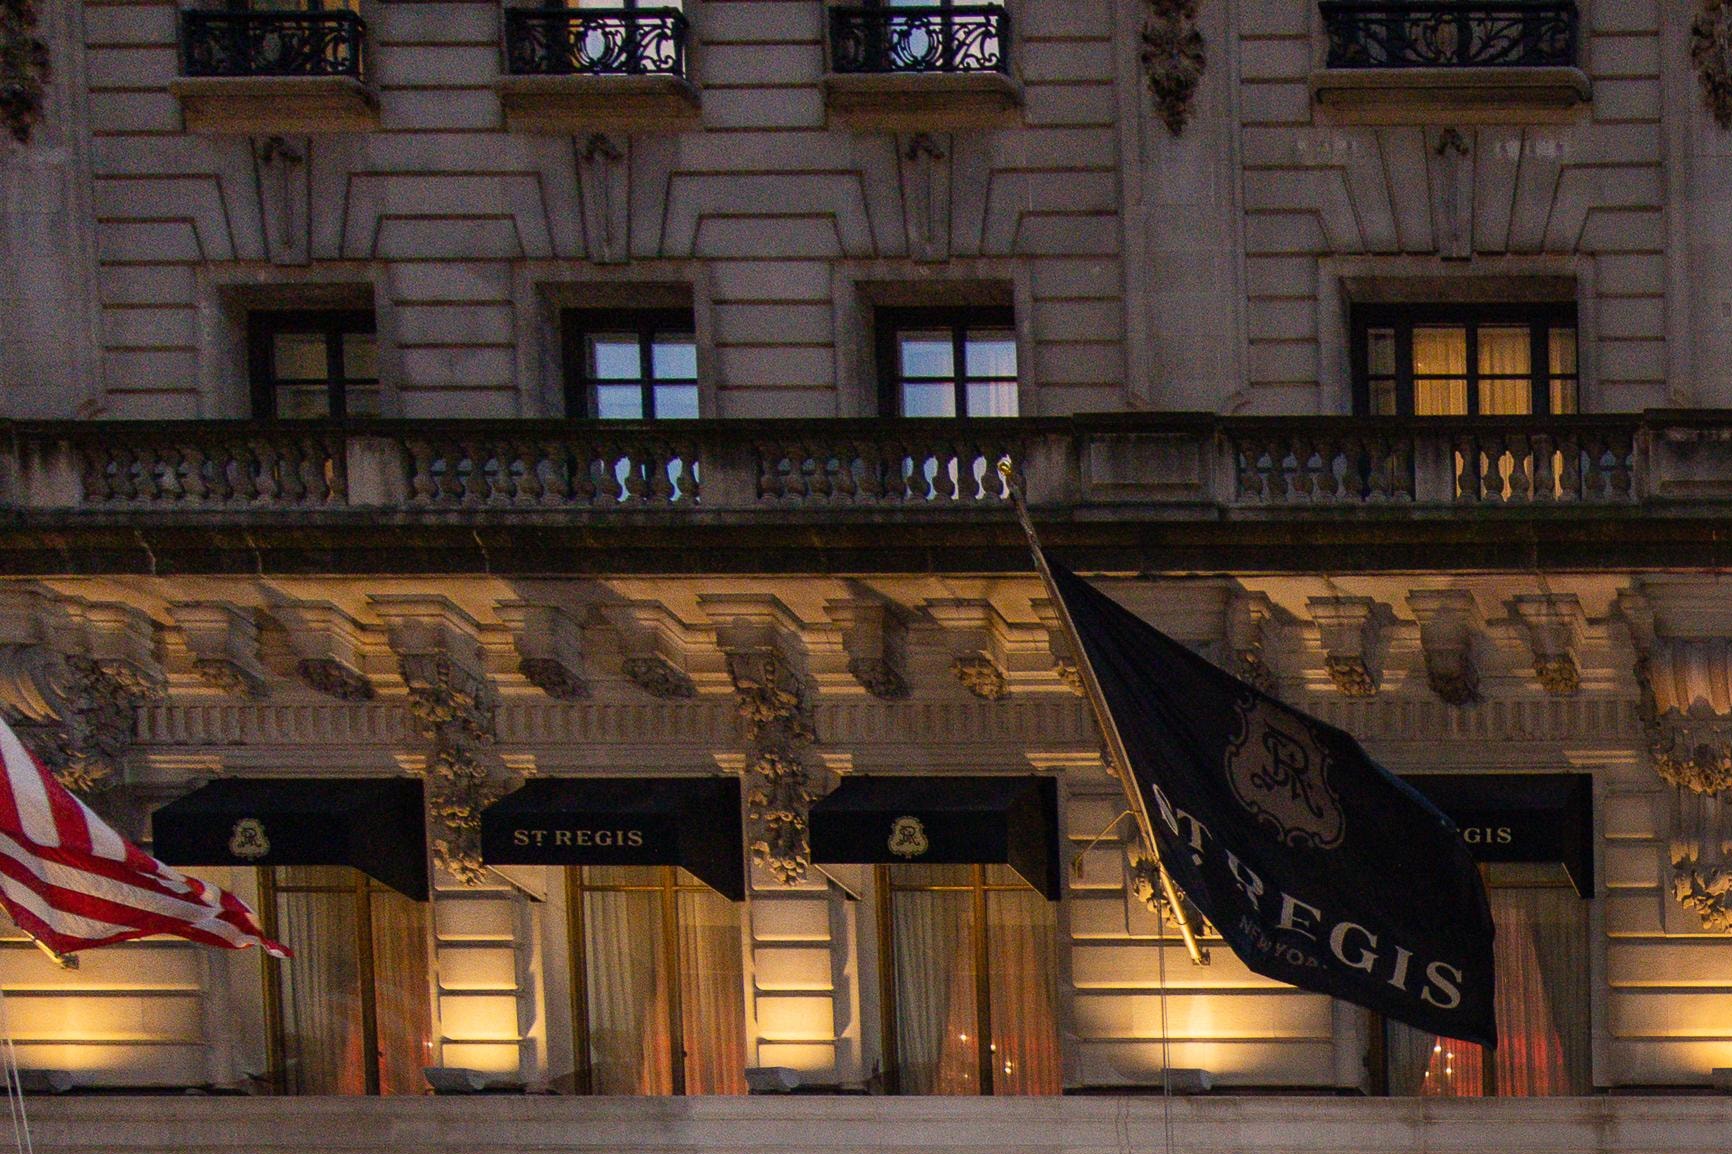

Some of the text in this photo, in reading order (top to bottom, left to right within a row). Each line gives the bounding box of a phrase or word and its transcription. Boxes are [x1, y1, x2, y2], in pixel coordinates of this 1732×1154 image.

[554, 829, 644, 847] REGIS
[1456, 827, 1512, 844] GIS
[1225, 849, 1463, 1009] REGIS
